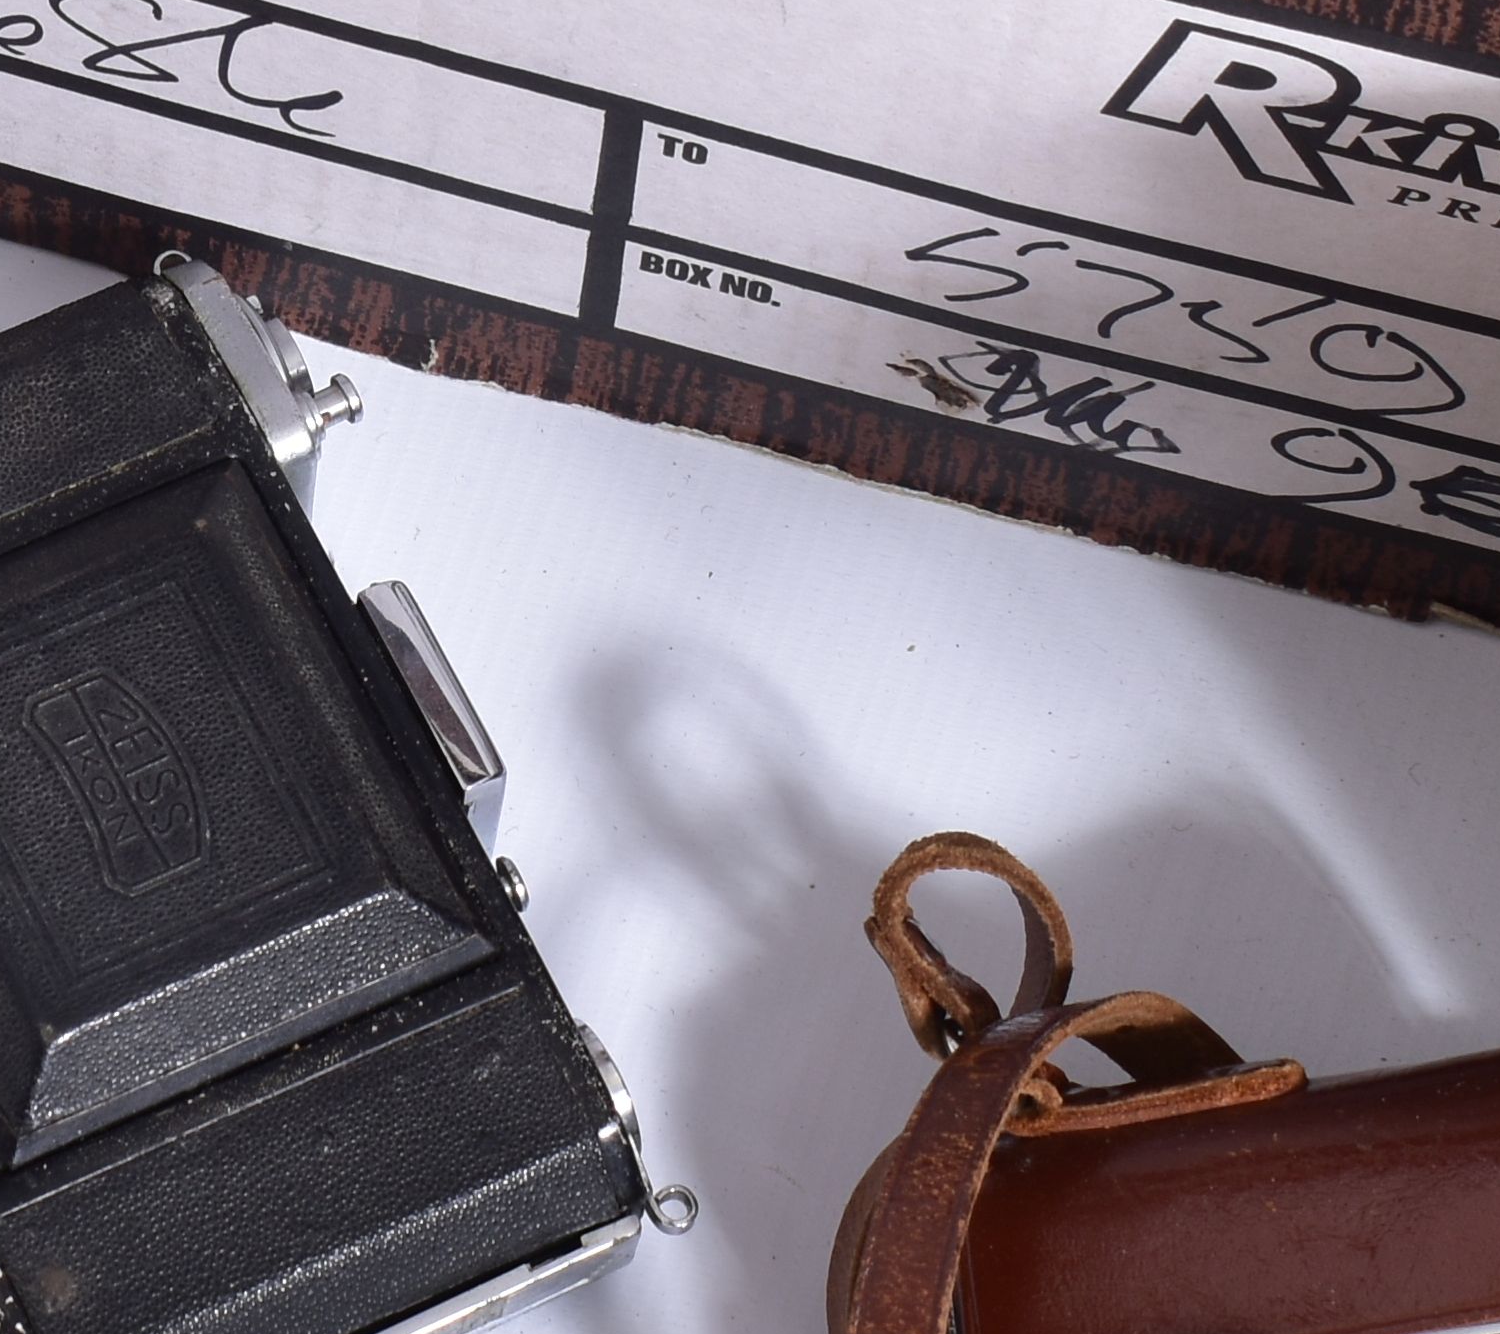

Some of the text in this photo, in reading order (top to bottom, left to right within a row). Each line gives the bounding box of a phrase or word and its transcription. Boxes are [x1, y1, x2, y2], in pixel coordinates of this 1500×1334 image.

[657, 132, 709, 166] TO
[638, 250, 781, 308] BOX NO.
[62, 733, 138, 846] IKON
[95, 699, 191, 837] ZEISS
